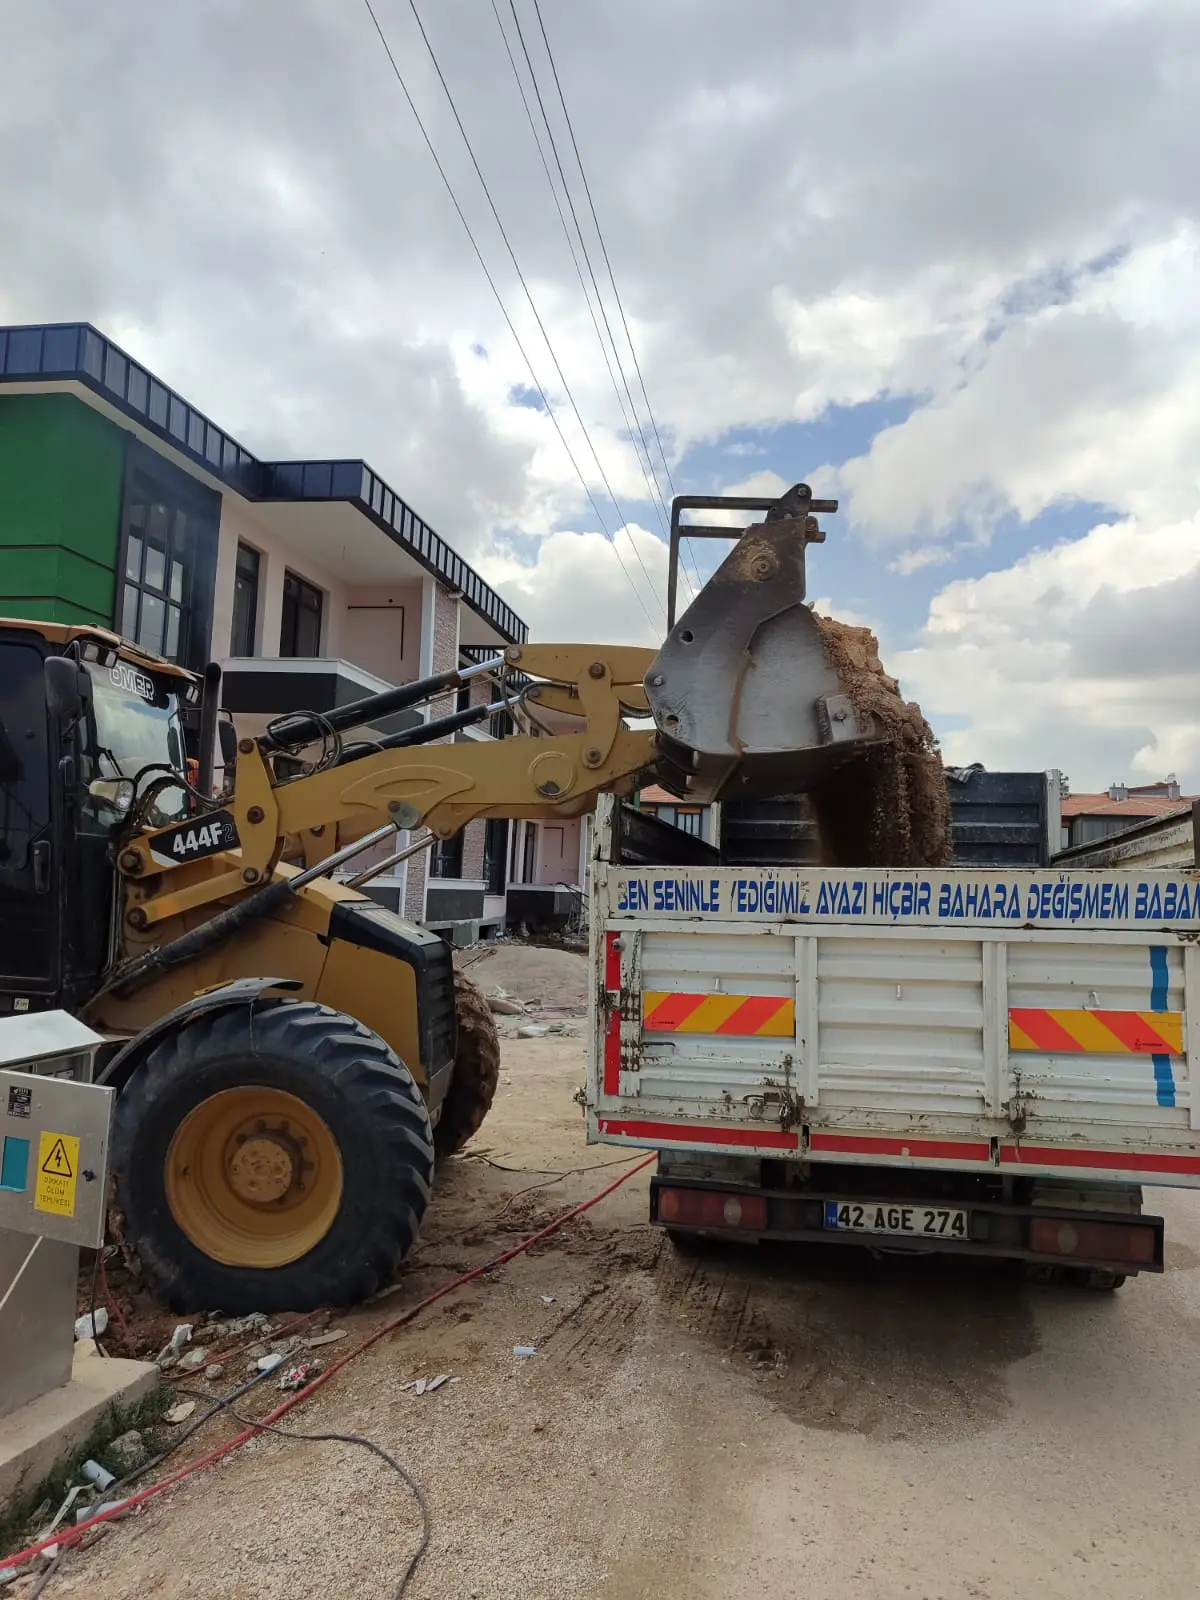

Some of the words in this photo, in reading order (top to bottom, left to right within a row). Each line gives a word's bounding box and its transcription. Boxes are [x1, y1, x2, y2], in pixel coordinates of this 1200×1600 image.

[173, 822, 234, 854] 444F2
[653, 872, 719, 912] SENİNLE
[816, 881, 867, 915] AYAZI
[872, 873, 931, 920] HİÇBİR
[938, 883, 1021, 919] BAHARA
[1027, 875, 1129, 923] DEĞİŞMEM
[838, 1205, 864, 1227] 42
[874, 1207, 914, 1230] AGE
[923, 1211, 965, 1236] 274
